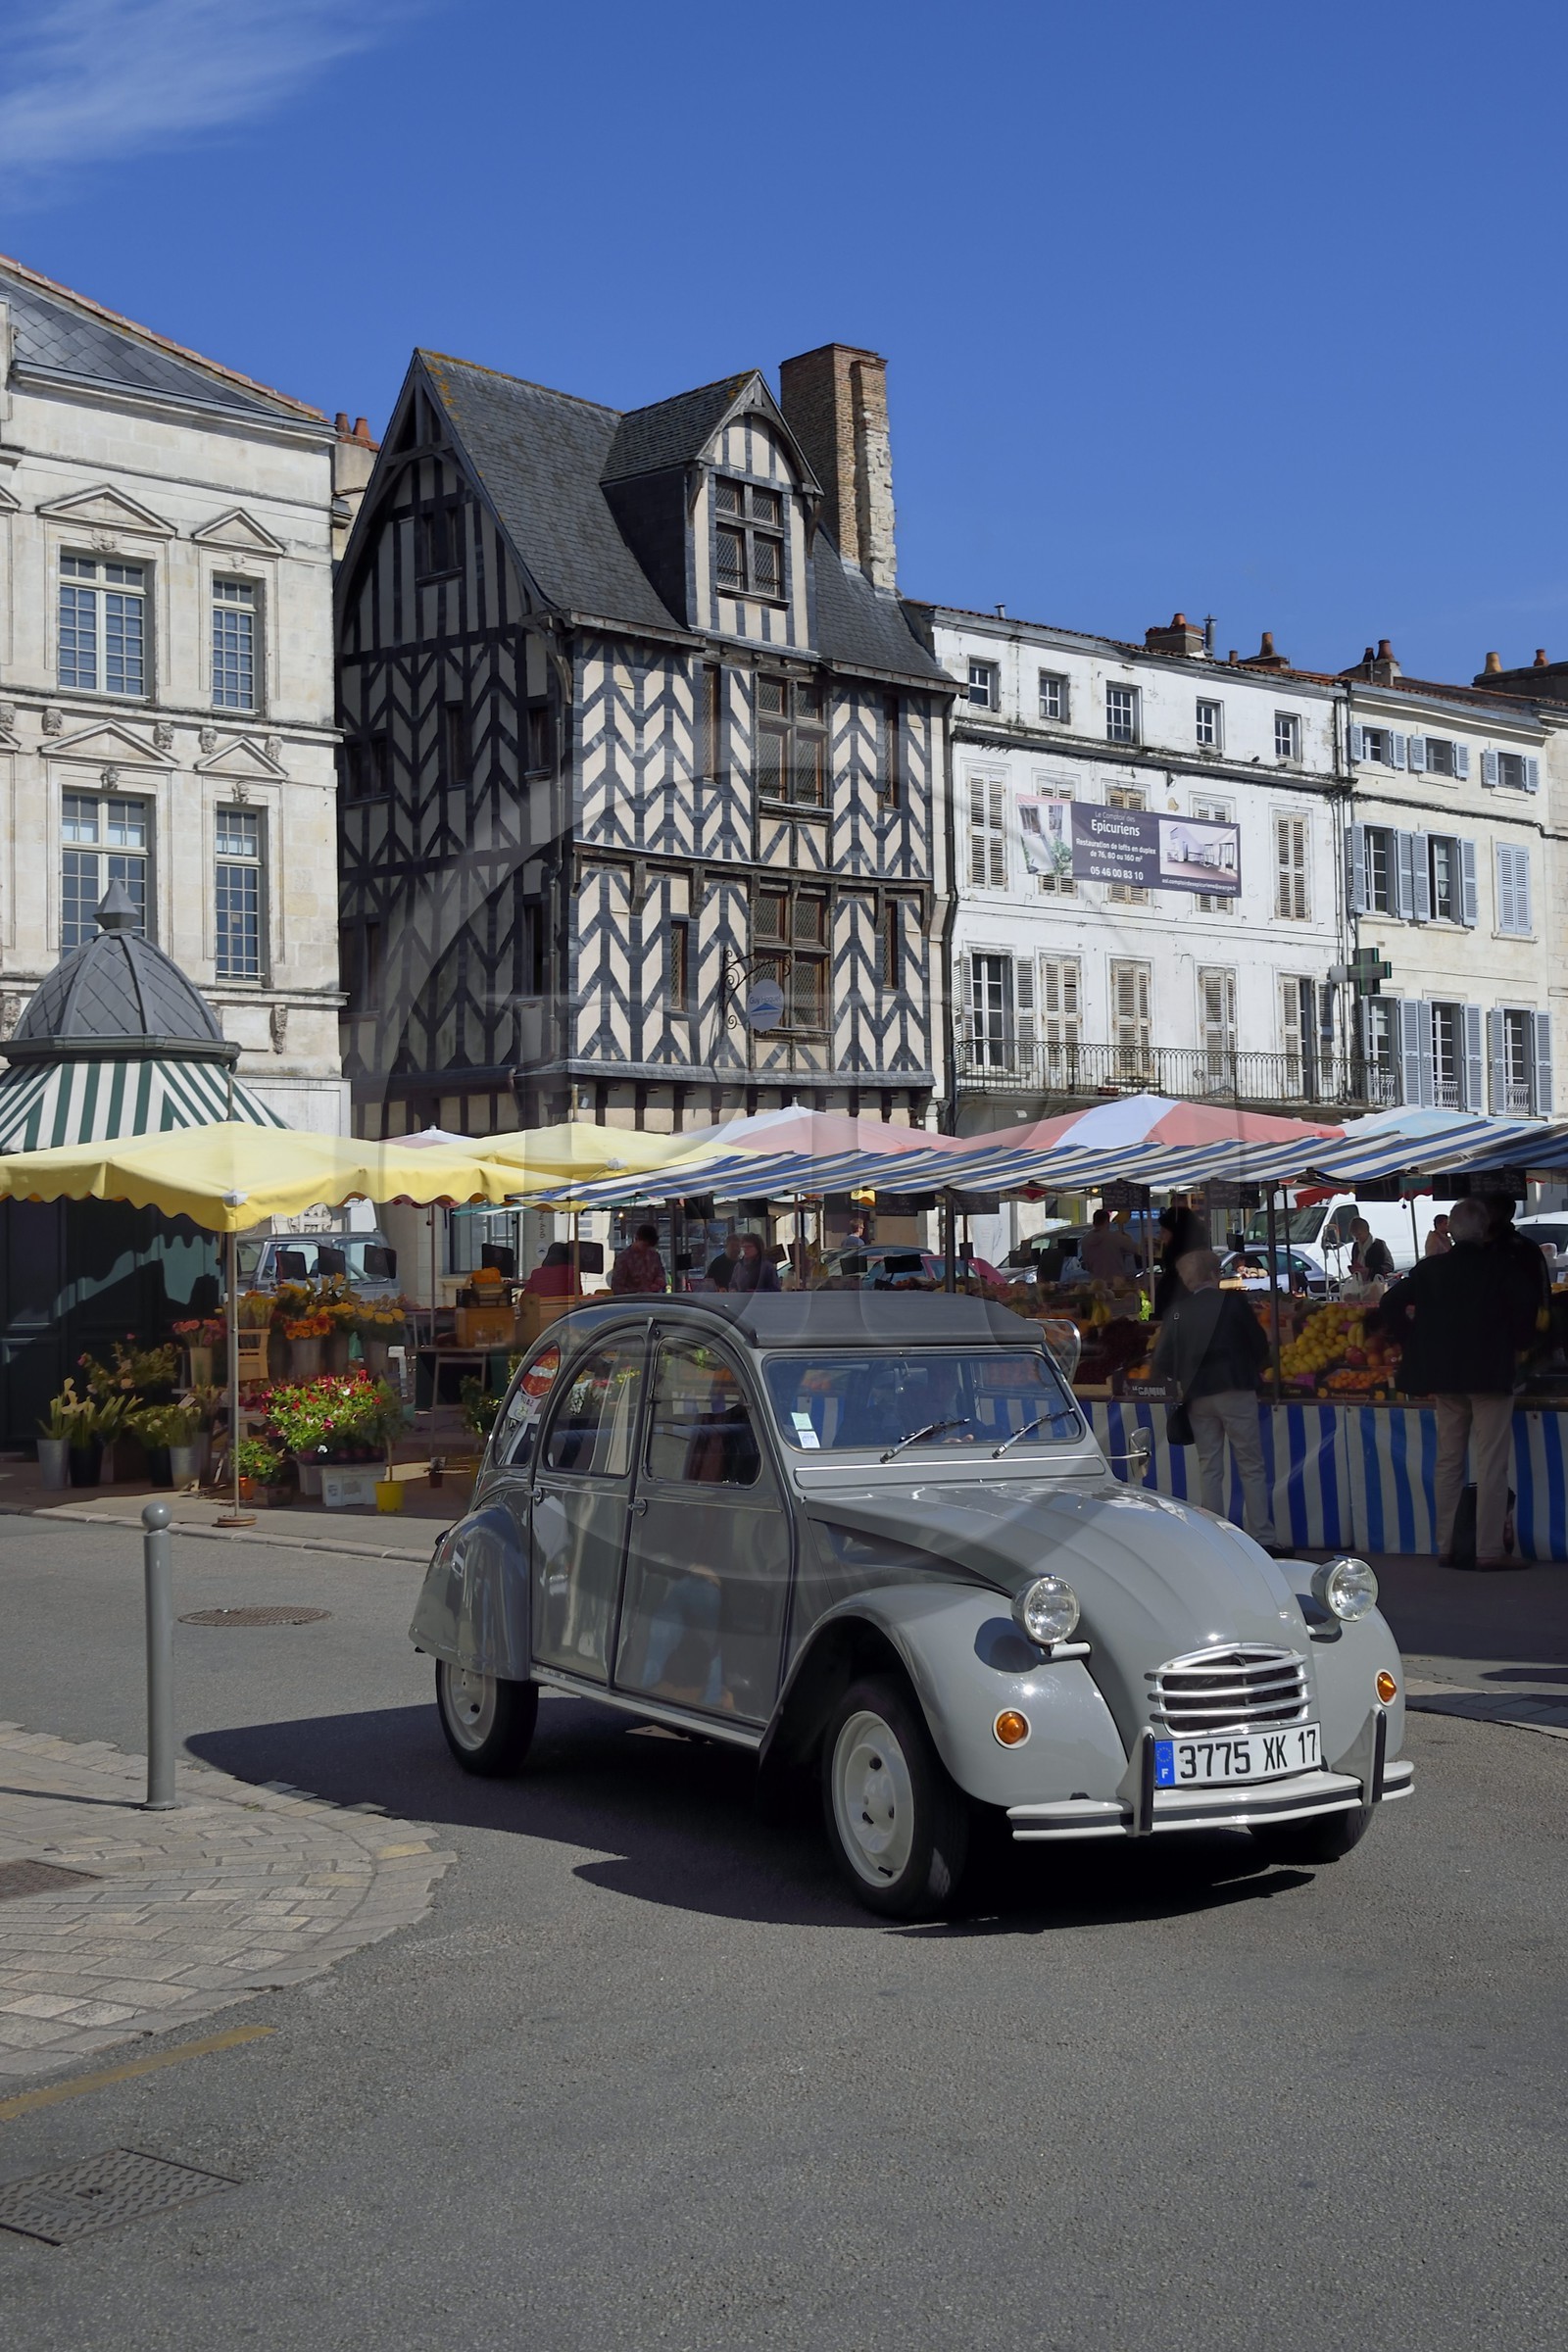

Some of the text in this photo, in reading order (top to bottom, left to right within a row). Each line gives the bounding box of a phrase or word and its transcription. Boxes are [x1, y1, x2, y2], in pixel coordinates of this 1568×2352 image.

[1102, 811, 1125, 821] Comptoir
[1091, 818, 1141, 837] Epicuriens
[1076, 838, 1109, 849] Restauration
[1090, 865, 1144, 880] 05 46 00 83 10
[750, 994, 782, 1004] Guy Hoquet
[1138, 1386, 1166, 1396] GAMIN
[1179, 1729, 1316, 1780] 3775 XK 17
[1160, 1768, 1169, 1779] F
